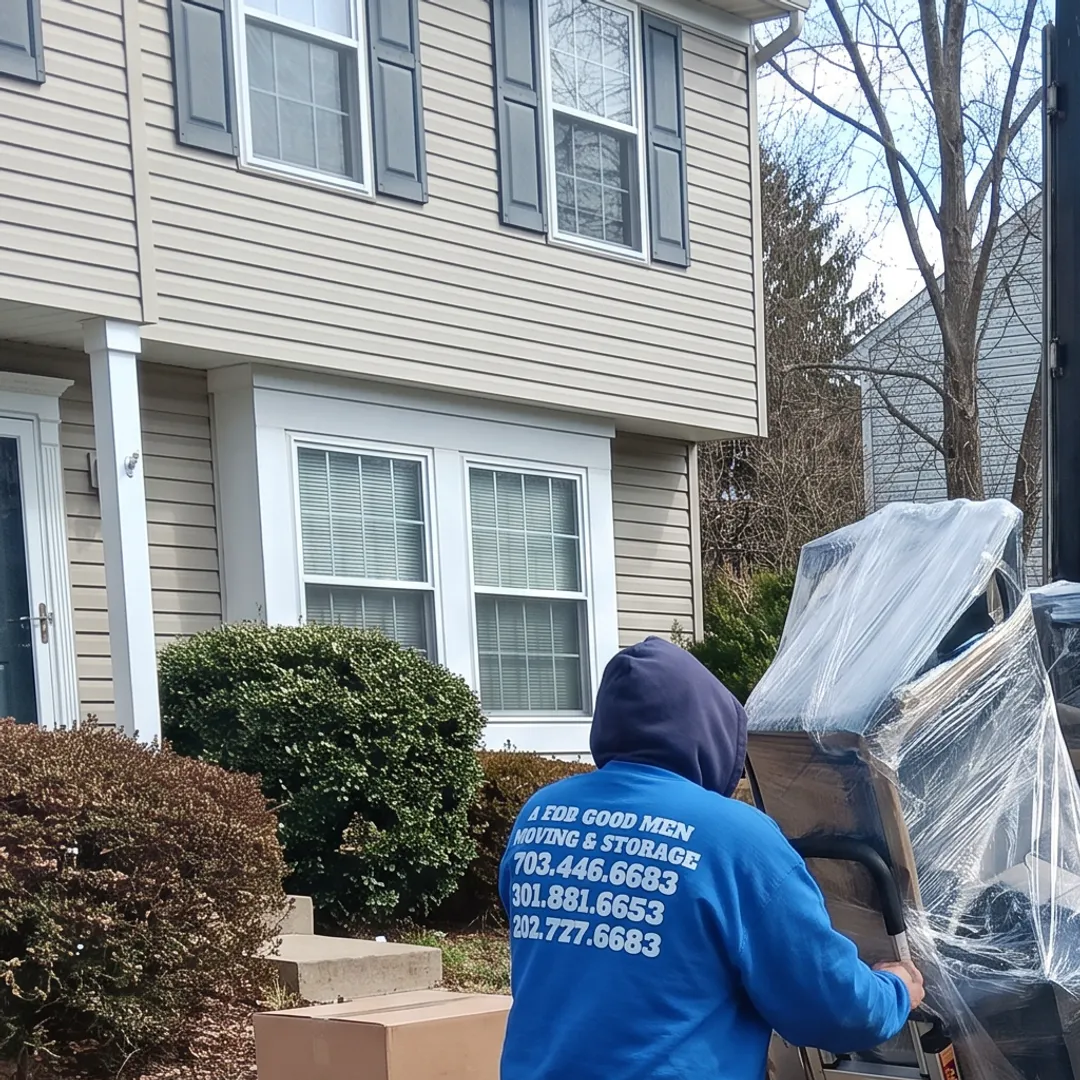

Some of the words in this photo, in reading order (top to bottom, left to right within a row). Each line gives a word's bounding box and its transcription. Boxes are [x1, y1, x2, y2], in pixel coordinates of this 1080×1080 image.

[527, 805, 541, 822] A
[581, 808, 637, 829] GOOD
[638, 815, 695, 842] MEN
[512, 826, 580, 848] MOVING
[582, 832, 597, 850] &
[600, 834, 702, 870] STORAGE
[513, 851, 679, 895] 703.446.6683
[511, 882, 665, 926] 301.881.6653
